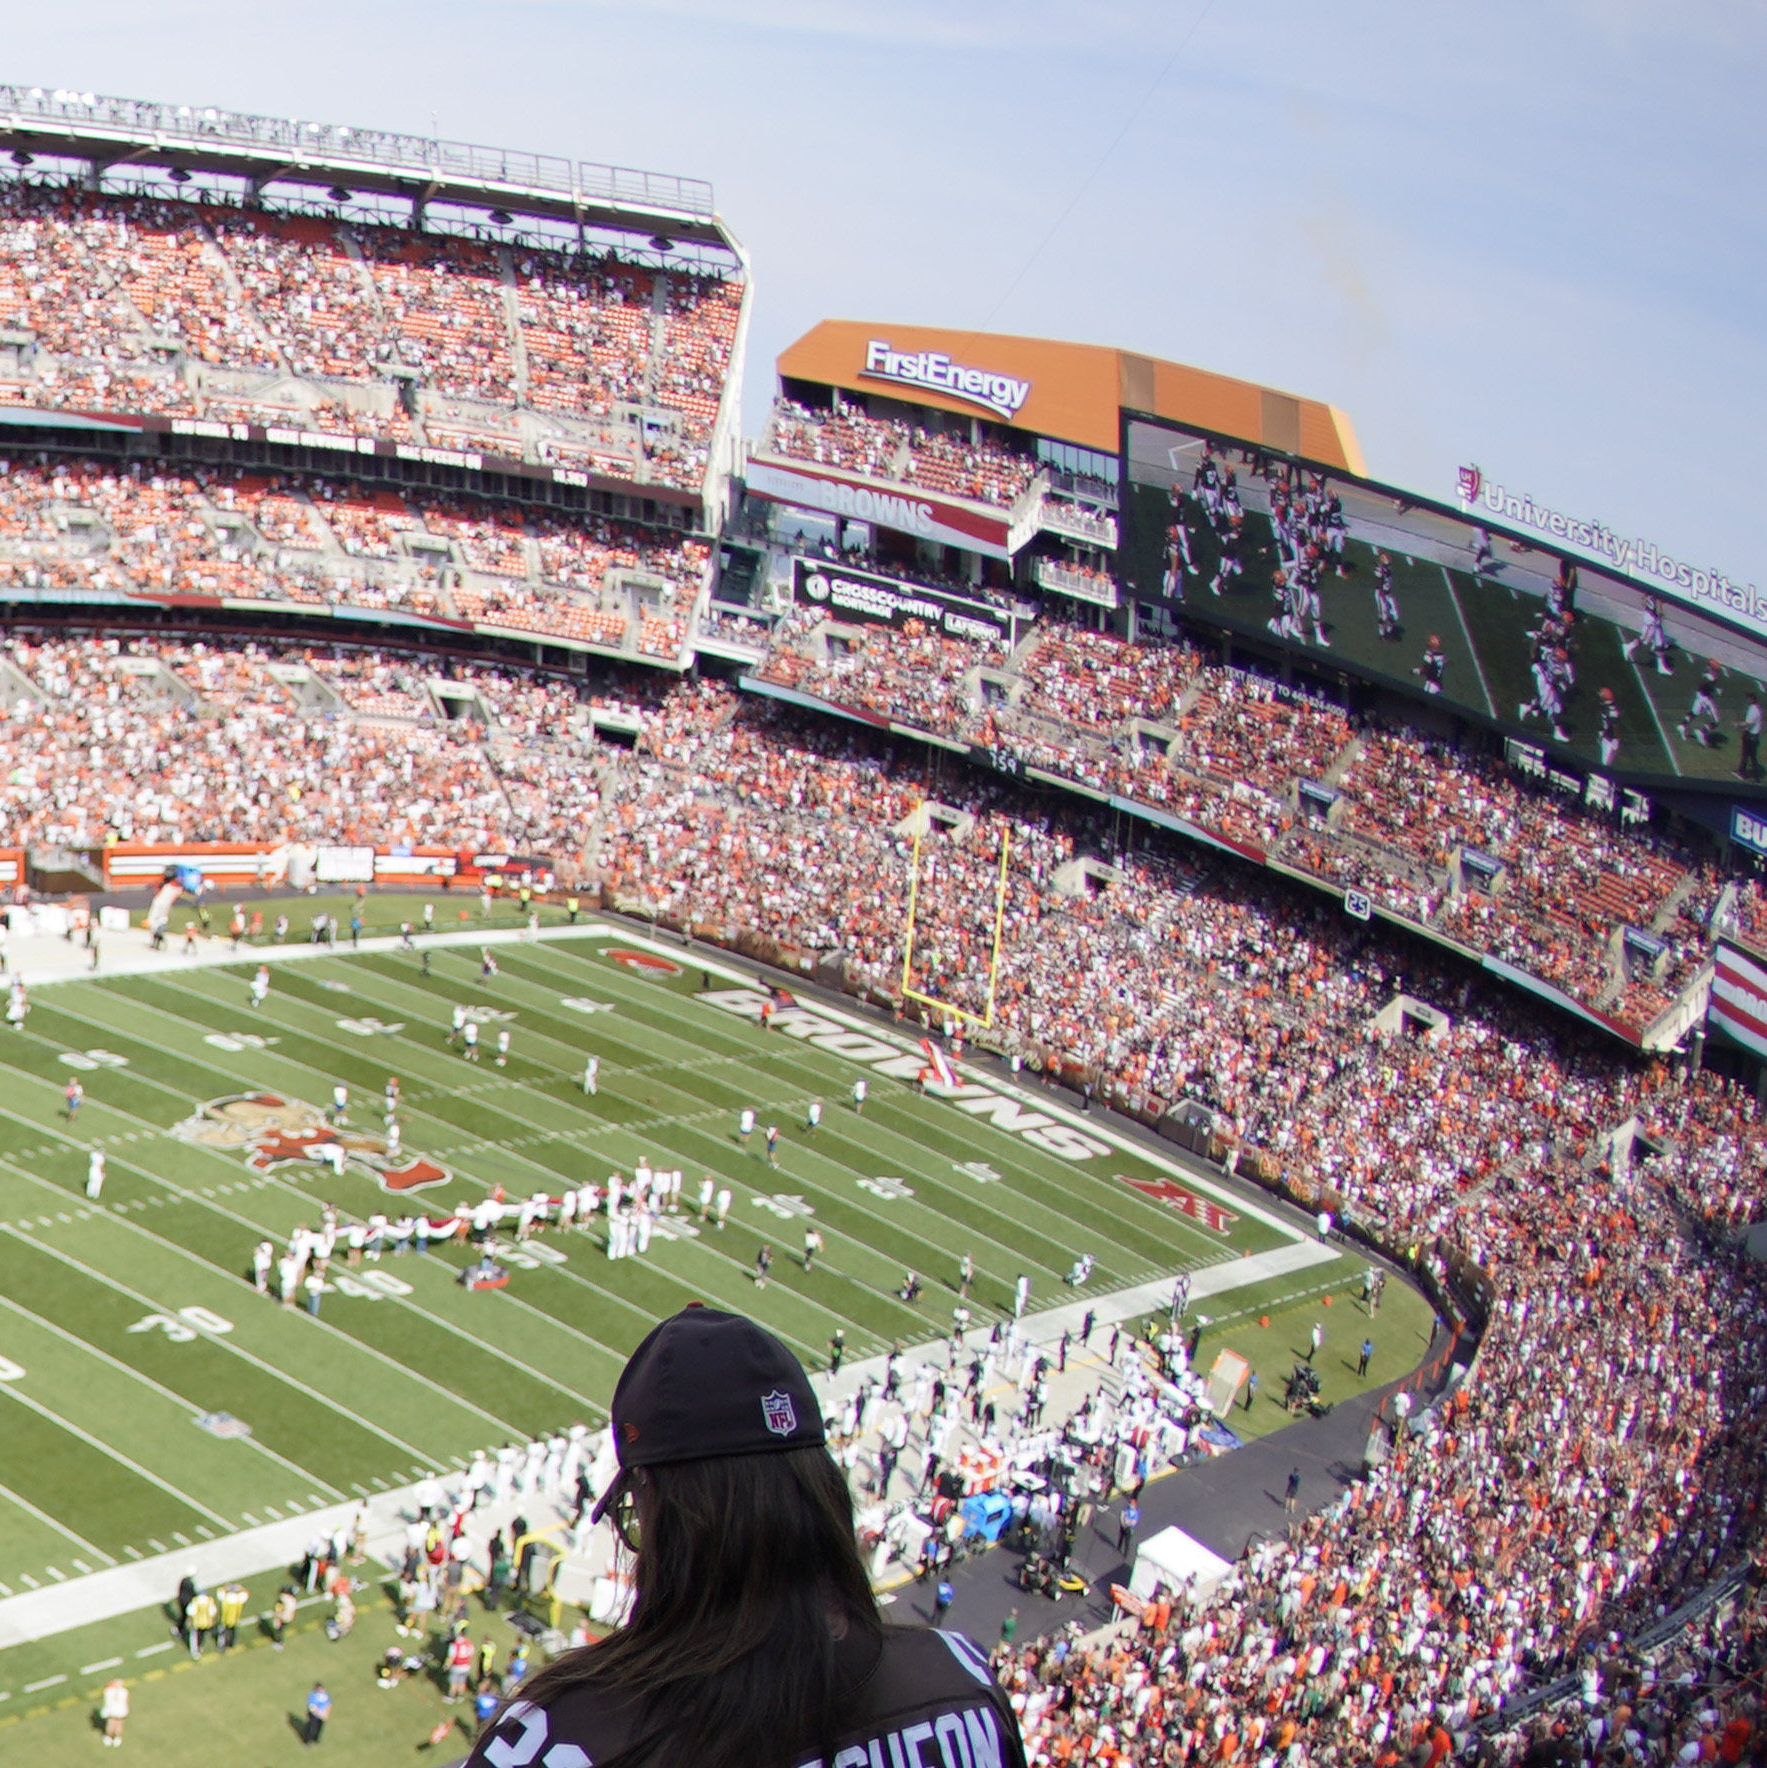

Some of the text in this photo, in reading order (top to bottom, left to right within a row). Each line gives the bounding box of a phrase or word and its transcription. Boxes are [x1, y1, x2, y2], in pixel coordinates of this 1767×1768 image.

[866, 339, 1031, 409] FirstEnergy
[819, 479, 935, 533] BROWNS
[1483, 480, 1767, 624] University Hospitals
[830, 578, 945, 622] CROSSCOUNTRY
[142, 1304, 235, 1343] 30
[769, 1411, 793, 1430] NFL
